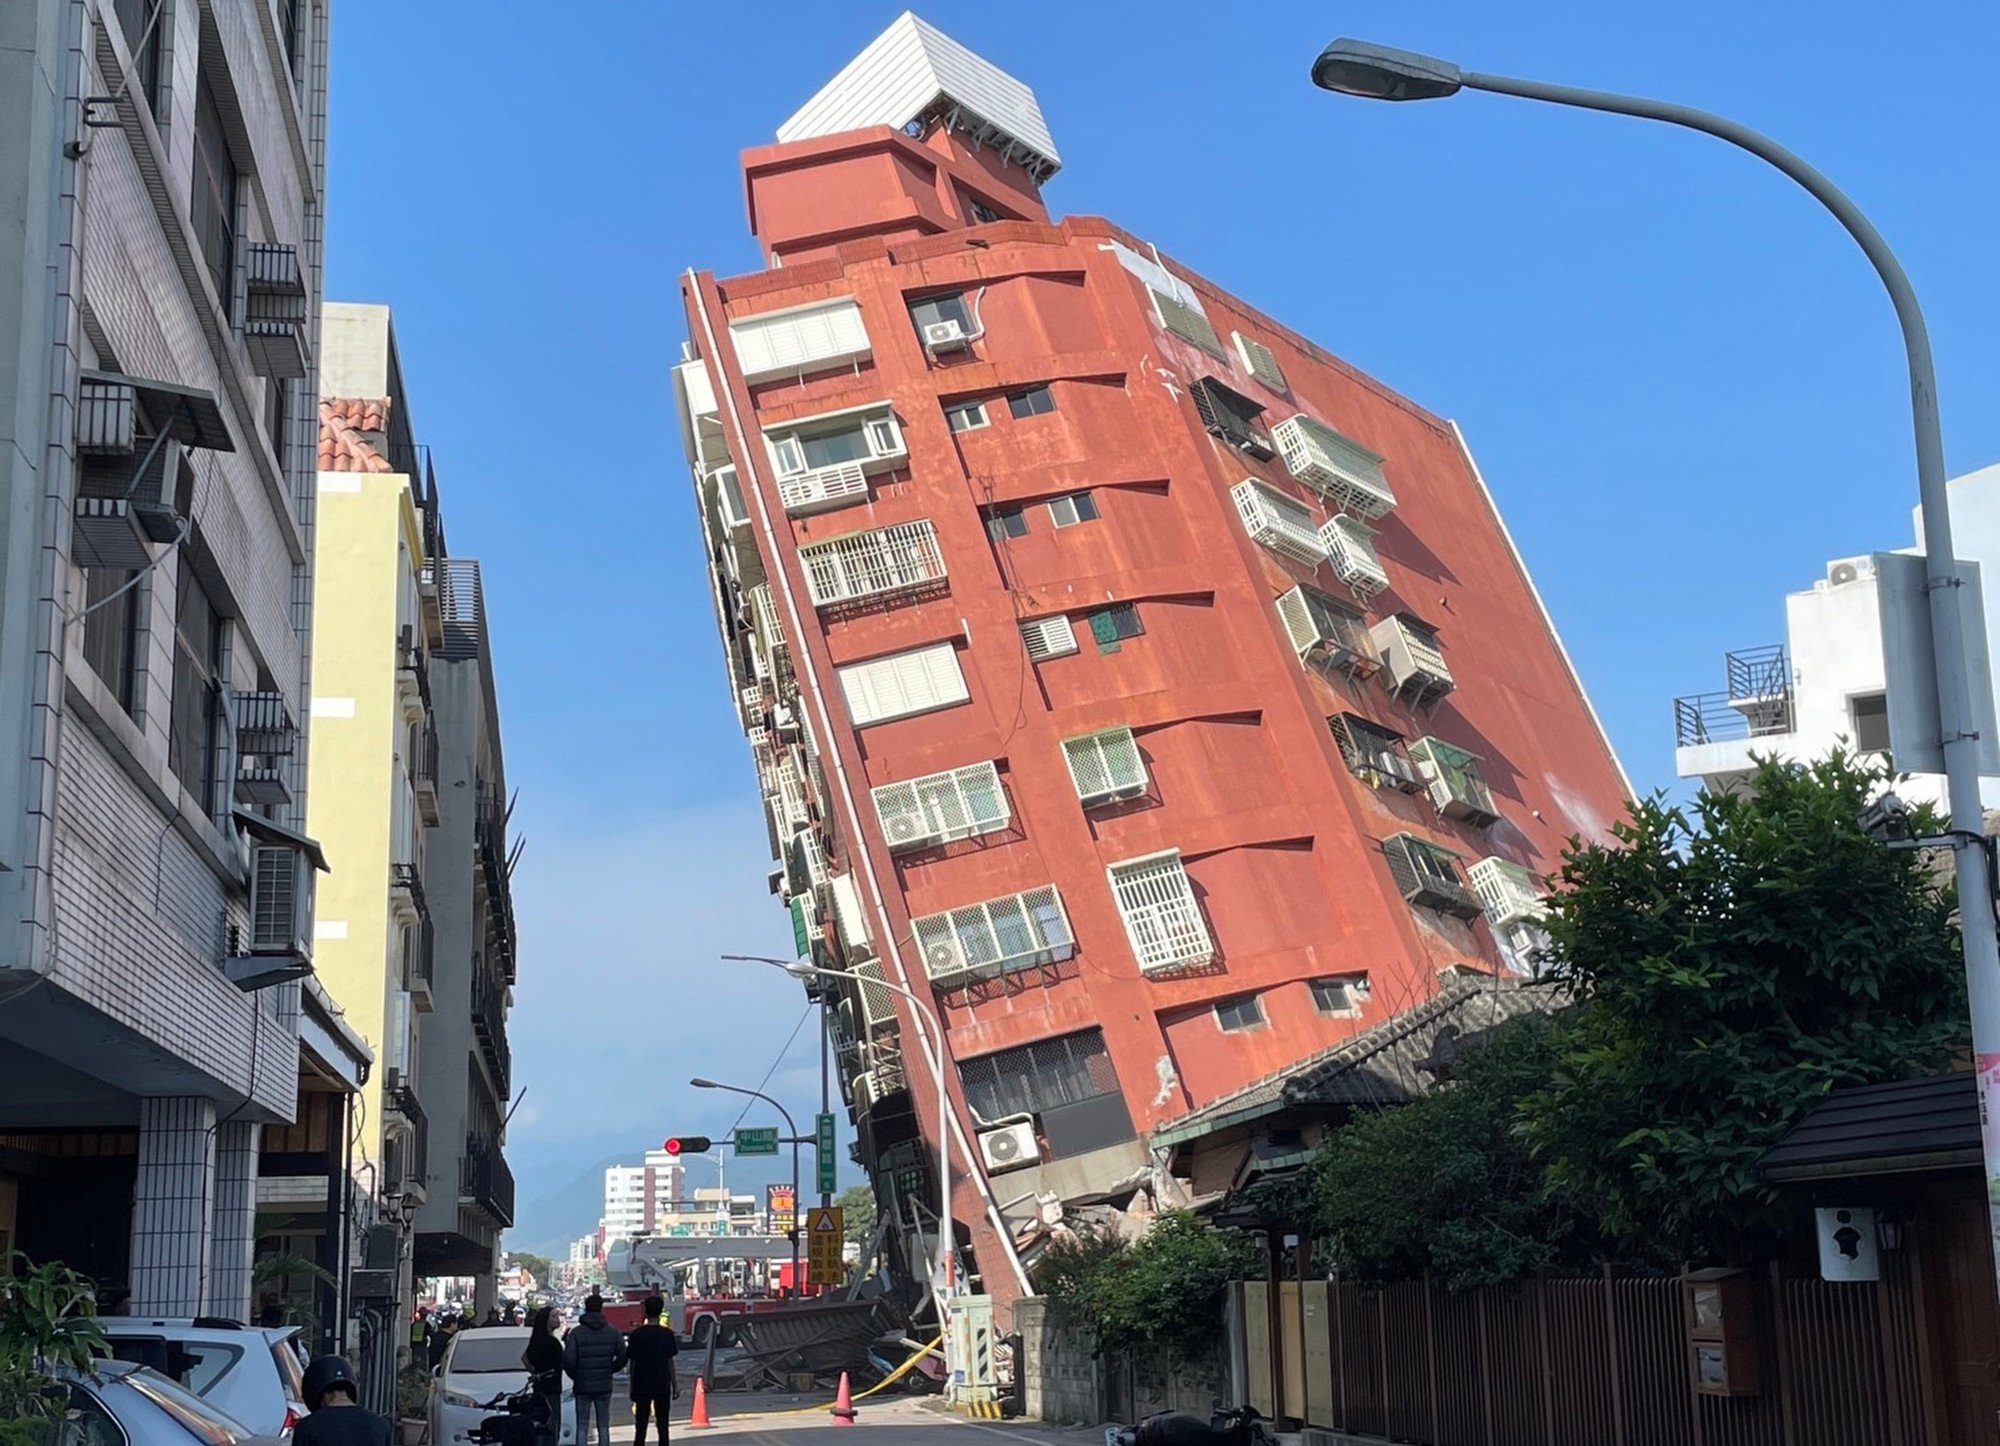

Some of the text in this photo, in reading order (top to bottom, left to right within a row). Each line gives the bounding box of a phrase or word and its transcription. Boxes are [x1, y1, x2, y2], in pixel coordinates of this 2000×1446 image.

[741, 1130, 774, 1142] 中山路
[827, 1233, 842, 1282] 科技執法
